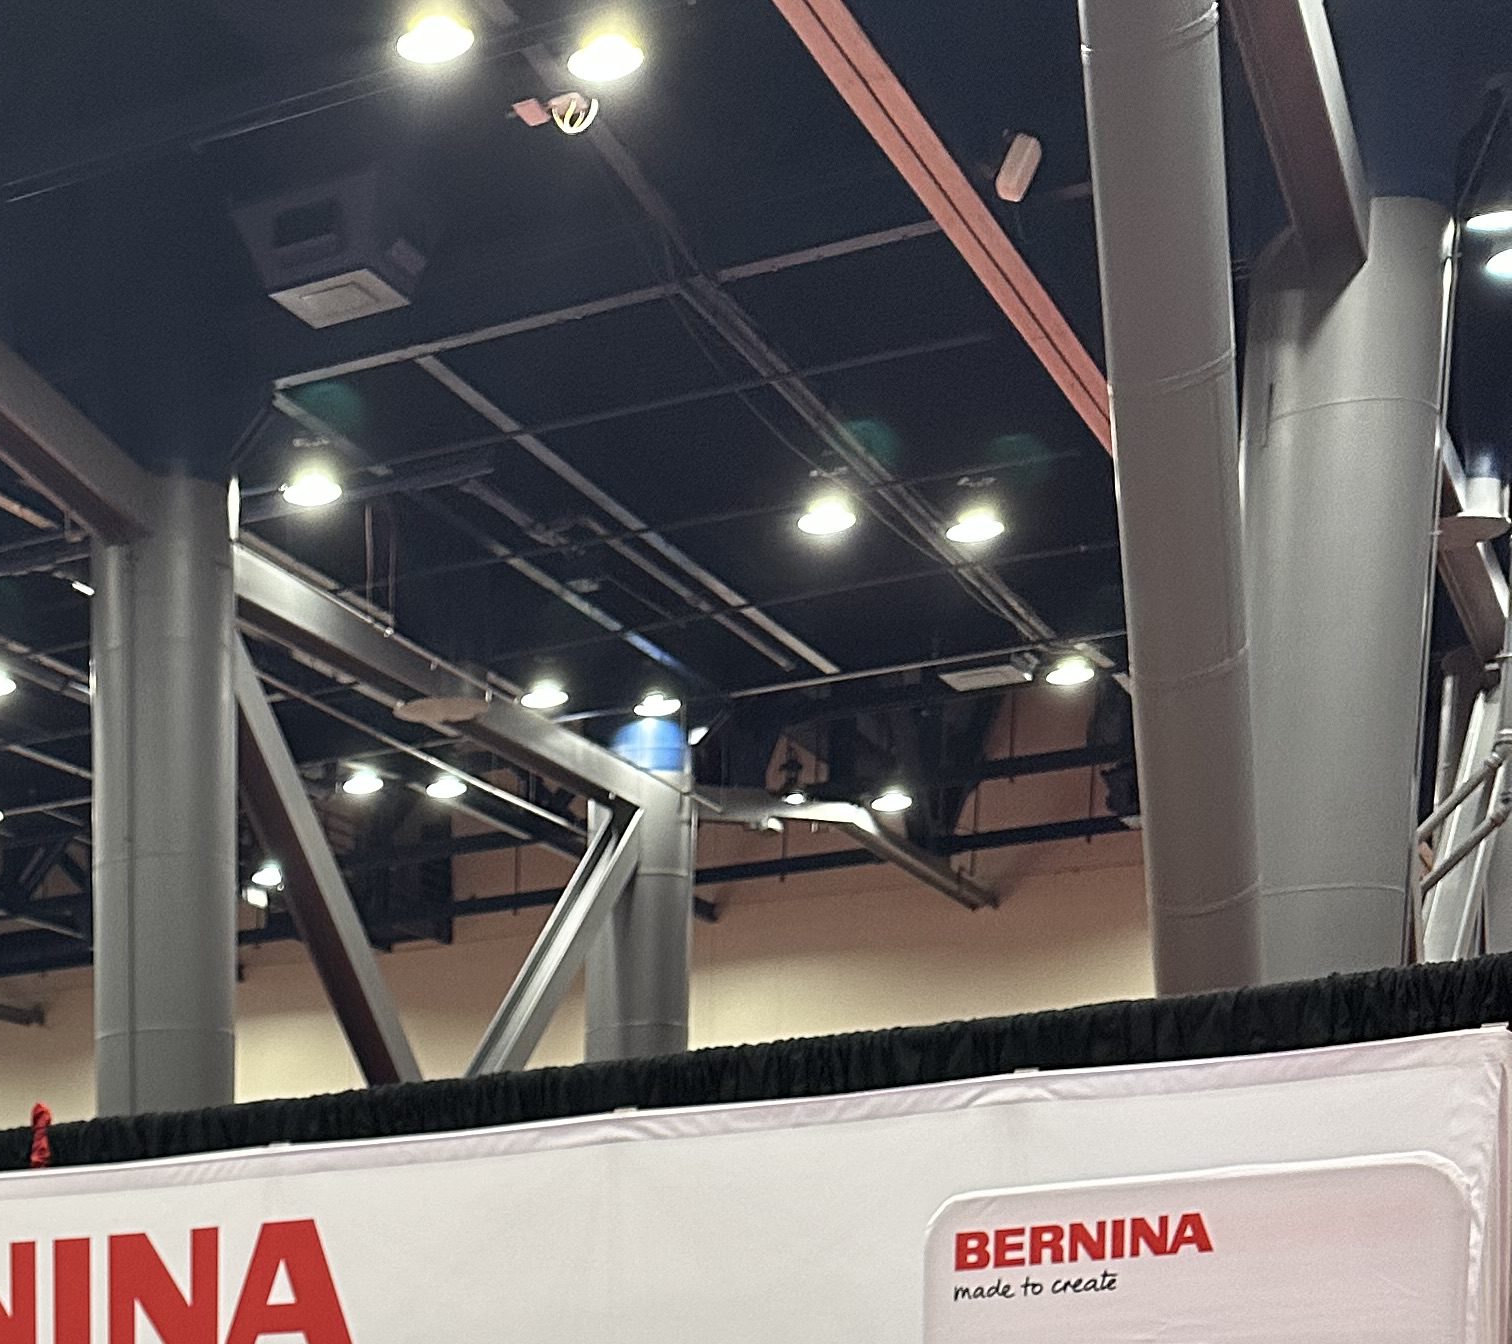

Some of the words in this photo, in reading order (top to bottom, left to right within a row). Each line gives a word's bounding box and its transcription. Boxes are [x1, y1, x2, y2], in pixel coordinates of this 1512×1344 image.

[954, 1212, 1214, 1272] BERNINA
[953, 1278, 1015, 1302] made
[1021, 1275, 1044, 1297] to
[1051, 1269, 1118, 1295] create
